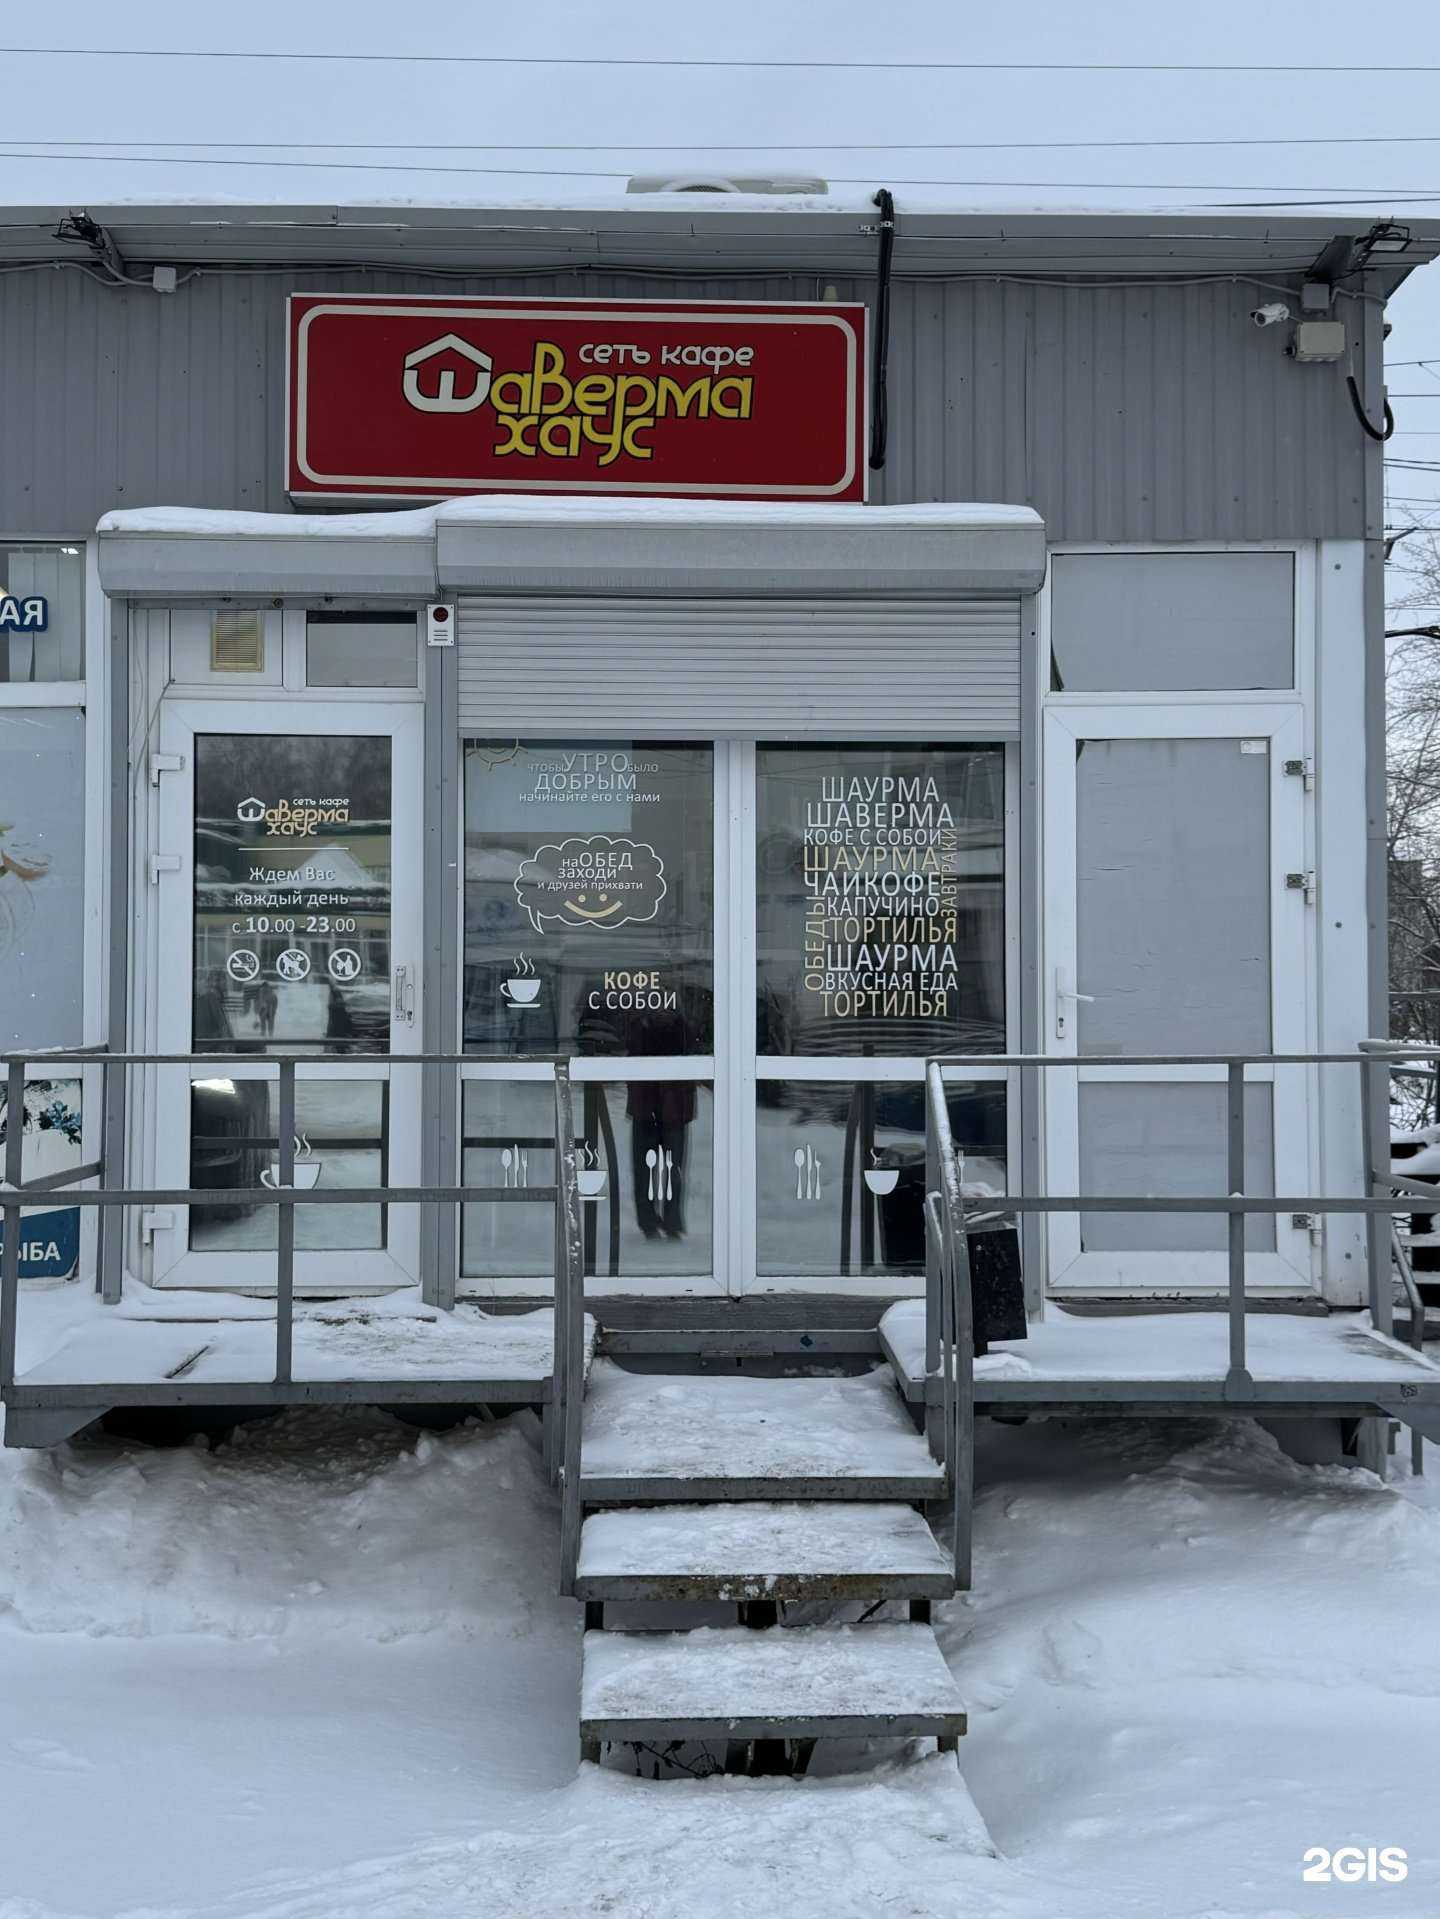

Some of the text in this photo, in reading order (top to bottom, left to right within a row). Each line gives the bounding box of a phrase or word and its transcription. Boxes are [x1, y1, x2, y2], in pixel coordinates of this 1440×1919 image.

[579, 343, 754, 375] сеть кафе
[494, 414, 655, 466] хаус
[534, 773, 637, 793] ДОБРЫМ
[822, 776, 940, 802] ШАУРМА
[292, 798, 350, 808] сеть кафе
[519, 790, 661, 803] начинайте его с нами
[807, 802, 955, 828] ШАВЕРМА
[266, 821, 318, 837] хаус
[804, 828, 854, 845] КОФЕ
[860, 828, 871, 845] С
[804, 846, 940, 871] ШАУРМА
[249, 866, 336, 884] Ждем Вас
[558, 867, 617, 881] заходи
[940, 828, 958, 917] ЗАВТРАКИ
[547, 879, 588, 892] друзей
[591, 881, 643, 891] прихвати
[235, 890, 349, 908] каждый день
[827, 896, 939, 916] КАПУЧИНО
[232, 922, 241, 933] с
[246, 916, 295, 933] 10.00
[829, 916, 957, 943] ТОРТИЛЬЯ
[804, 896, 830, 991] ОБЕДЫ
[827, 943, 958, 972] ШАУРМА
[604, 970, 660, 990] КОФЕ
[825, 972, 958, 995] ВКУСНАЯ ЕДА
[588, 991, 601, 1010] С
[820, 991, 947, 1017] ТОРТИЛЬЯ
